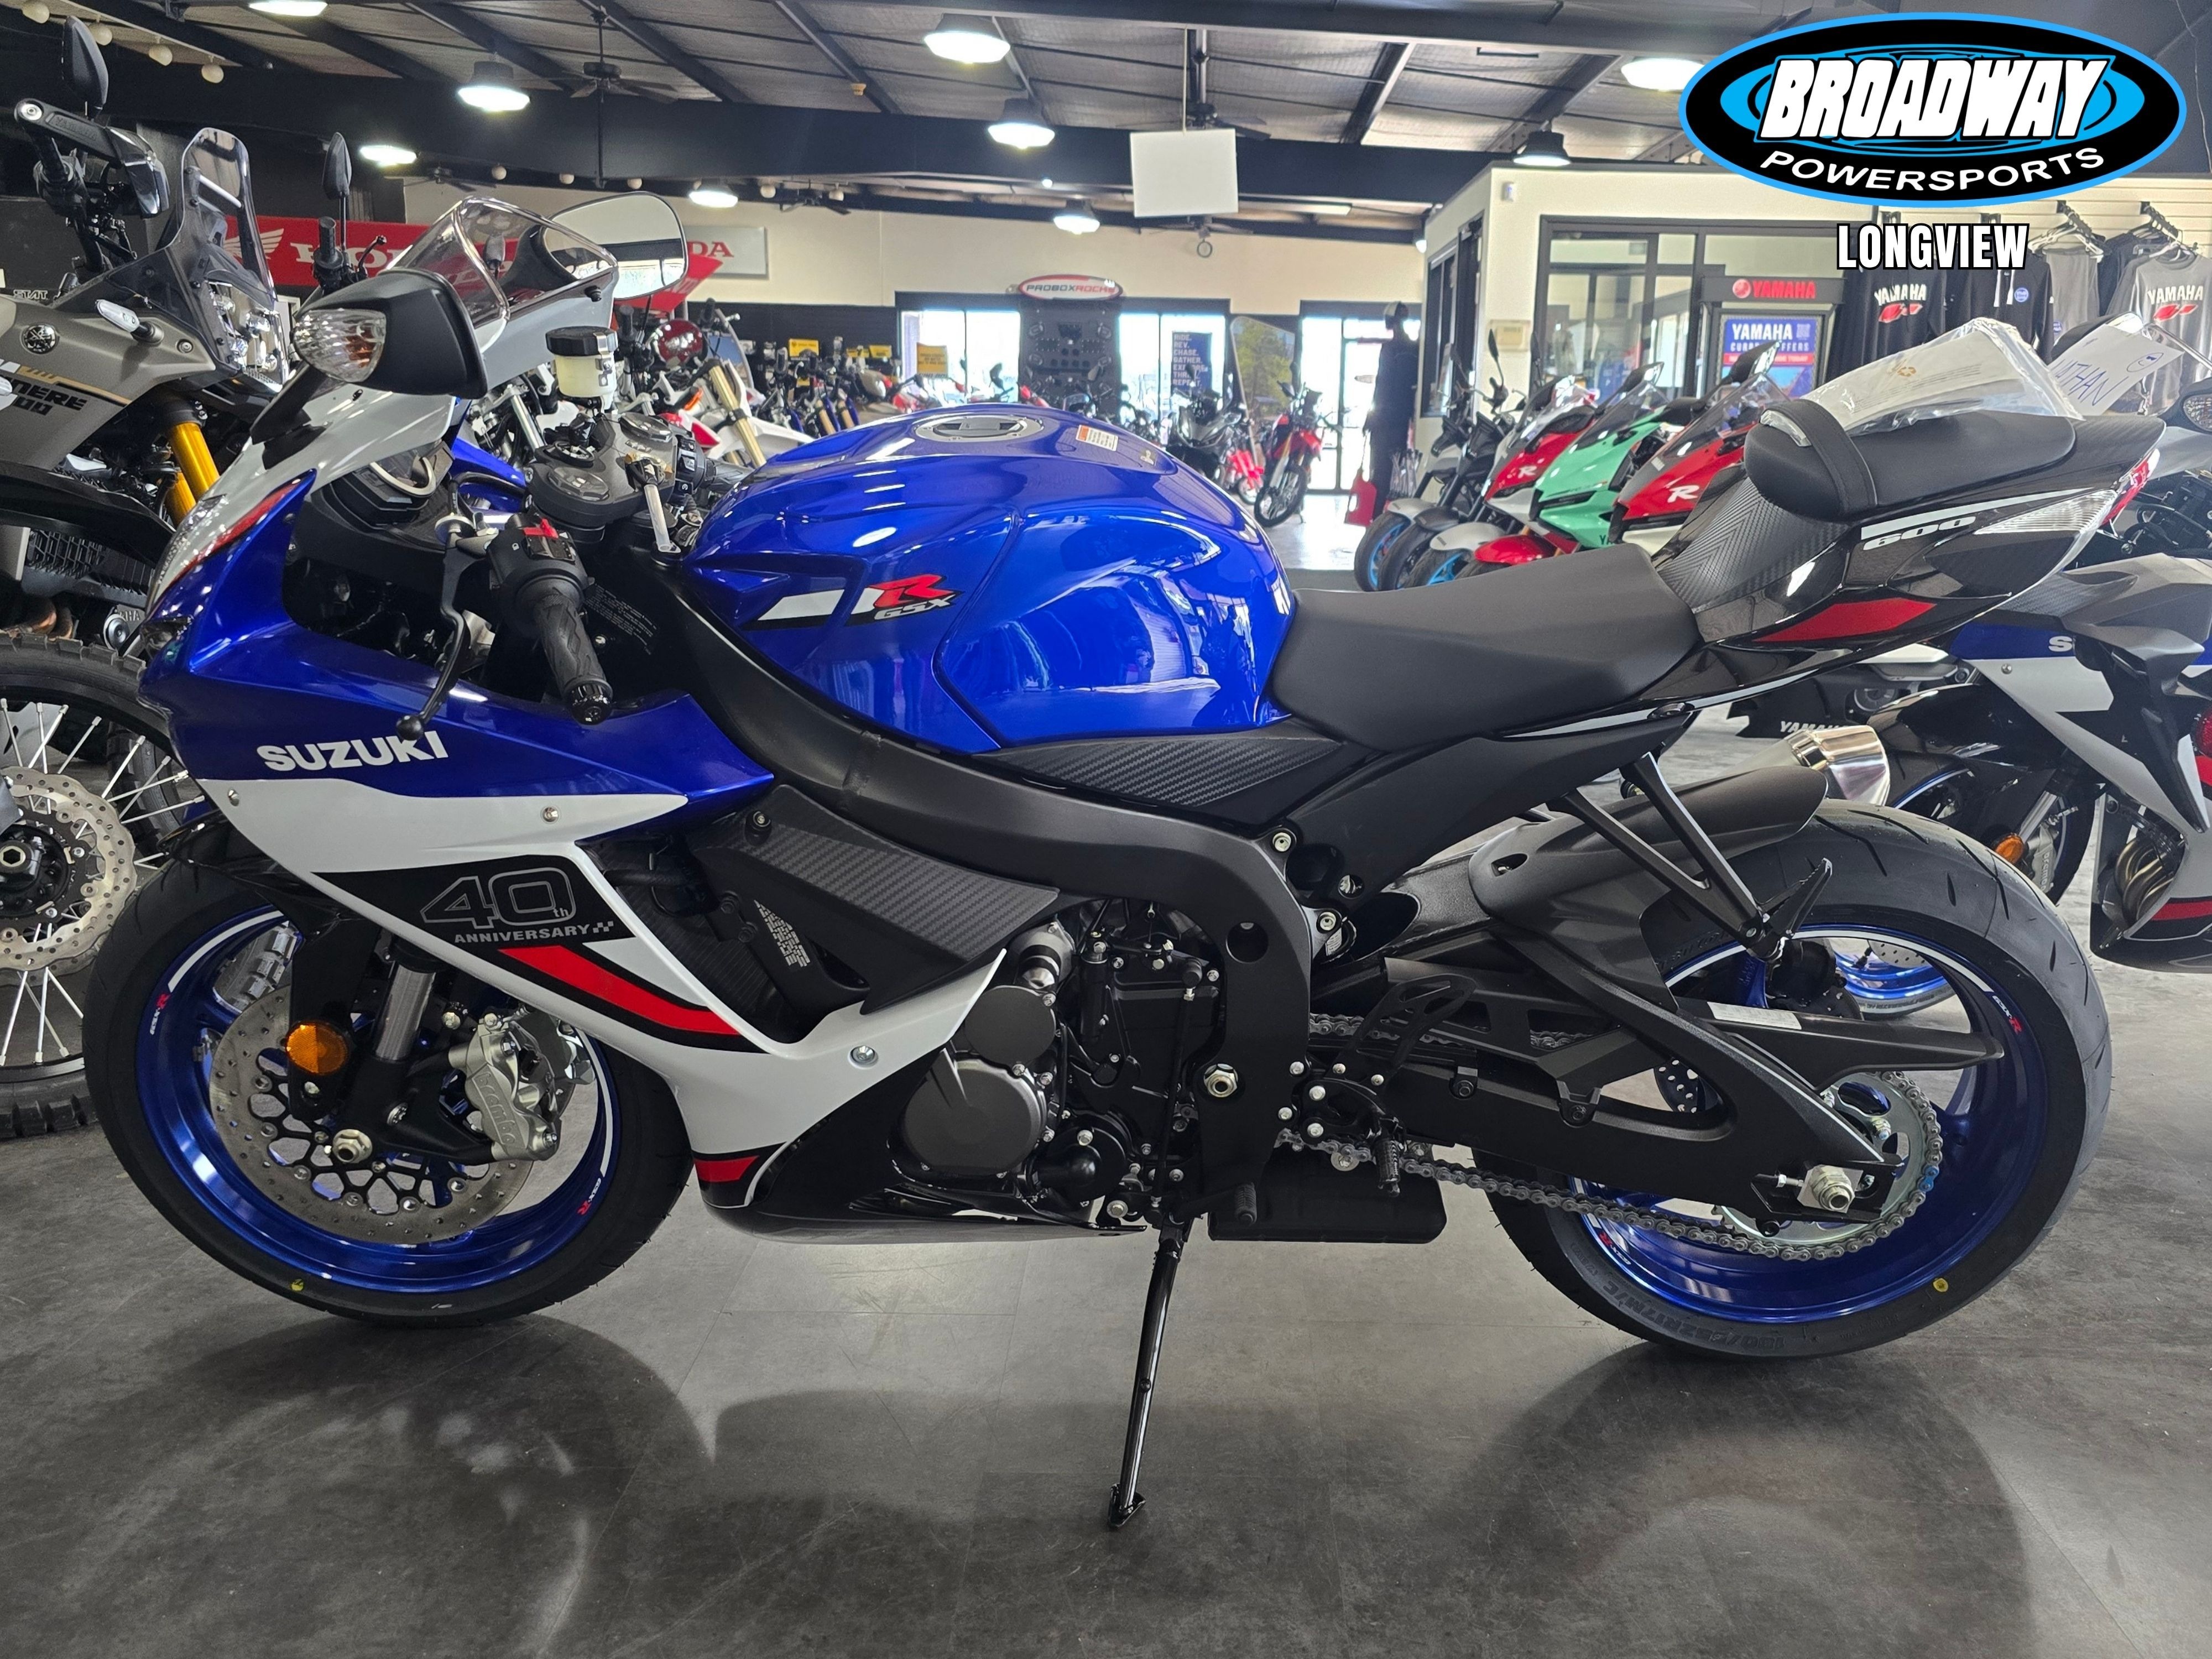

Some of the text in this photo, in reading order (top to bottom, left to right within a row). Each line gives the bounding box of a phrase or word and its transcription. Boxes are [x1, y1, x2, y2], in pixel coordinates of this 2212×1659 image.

[1752, 280, 1815, 299] YAMAHA
[1874, 284, 1927, 305] YAMAHA
[2148, 285, 2204, 304] YAMAHA
[1732, 324, 1793, 340] YAMAHA
[1778, 343, 1810, 351] FFERS
[1667, 485, 1700, 503] R
[1863, 516, 1976, 551] 600
[874, 593, 956, 620] GSX
[257, 730, 448, 771] SUZUKI
[455, 924, 590, 944] ANNIVERSARY
[474, 1070, 516, 1146] brembo
